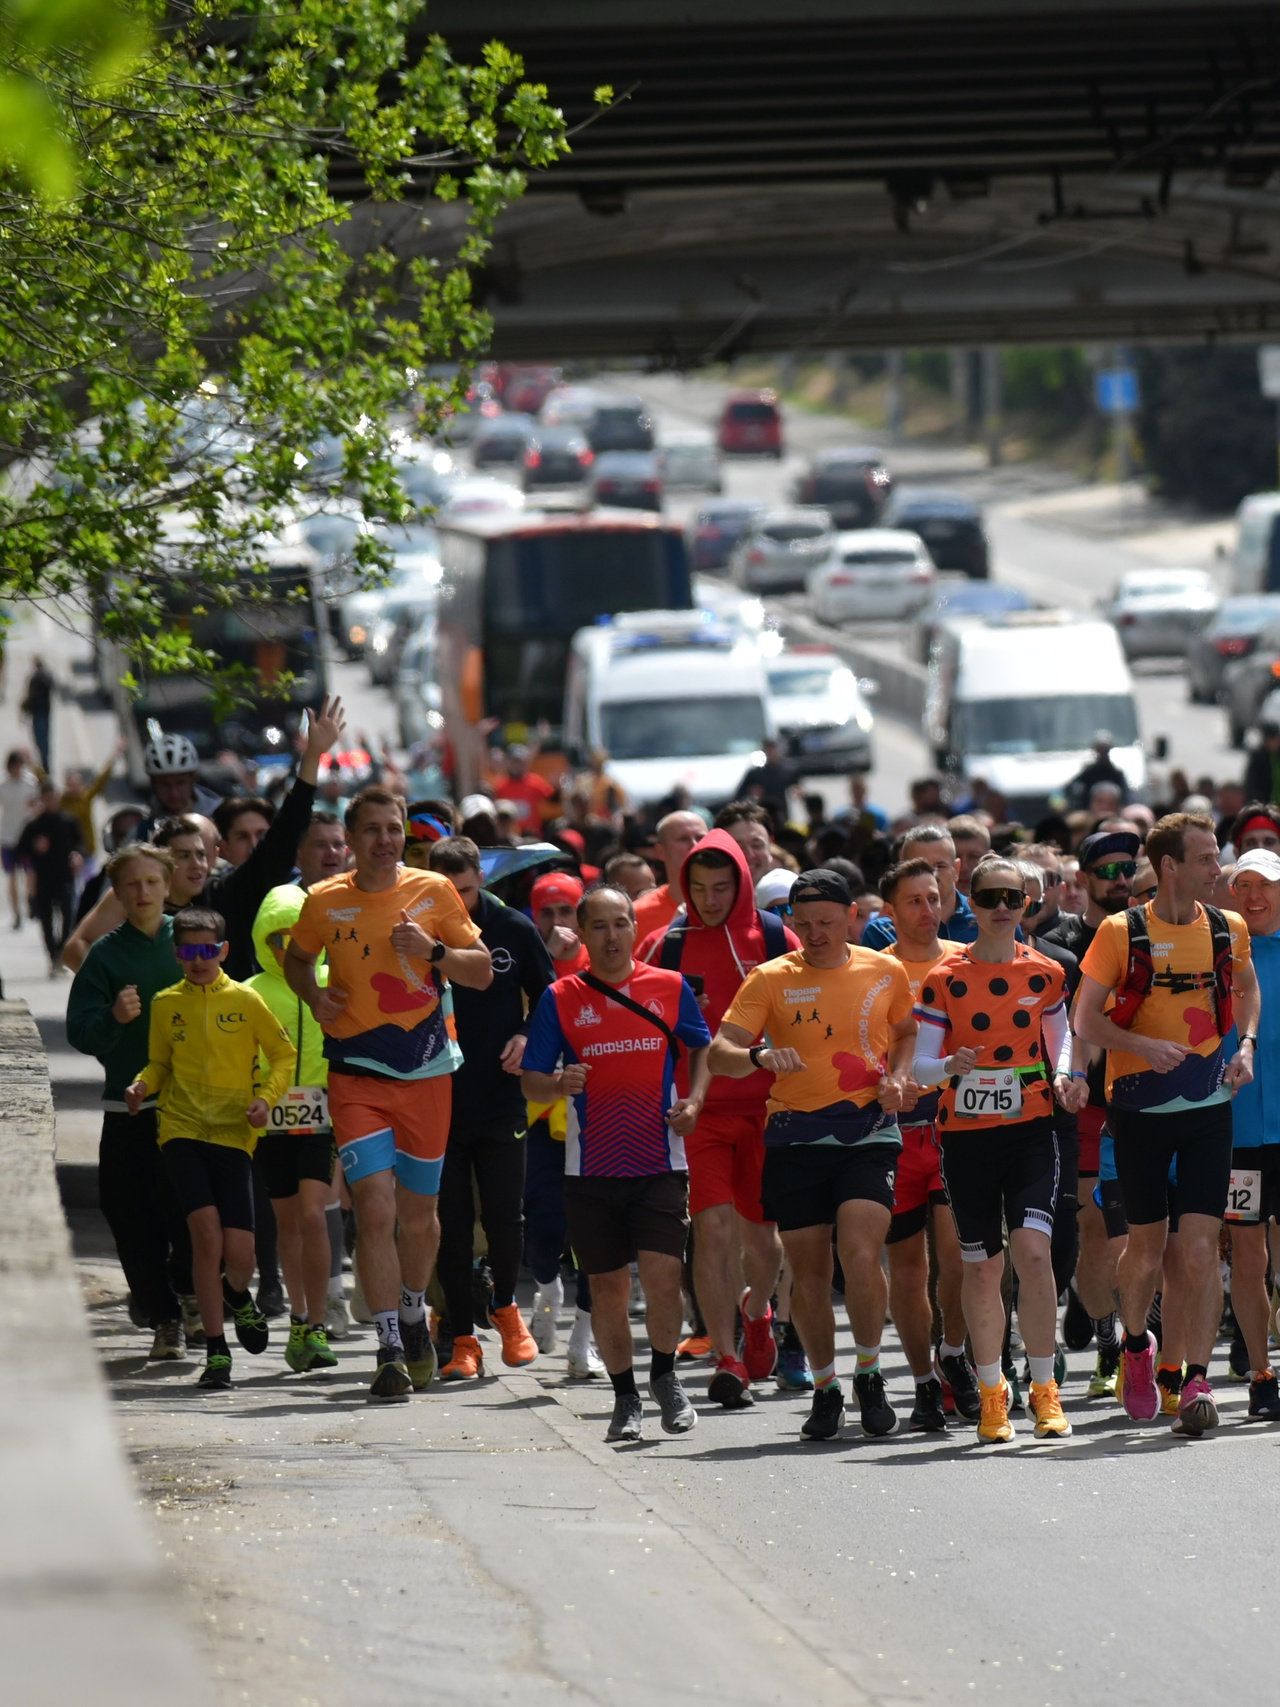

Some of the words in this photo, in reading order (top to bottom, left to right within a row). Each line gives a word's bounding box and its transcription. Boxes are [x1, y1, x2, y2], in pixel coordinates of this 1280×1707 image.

[784, 986, 822, 997] Первая
[784, 994, 816, 1005] линия
[219, 1012, 247, 1023] LCL
[582, 1038, 663, 1058] #ЮФУЗАБЕГ
[963, 1088, 1012, 1111] 0715
[271, 1104, 325, 1127] 0524
[1229, 1189, 1251, 1211] 12
